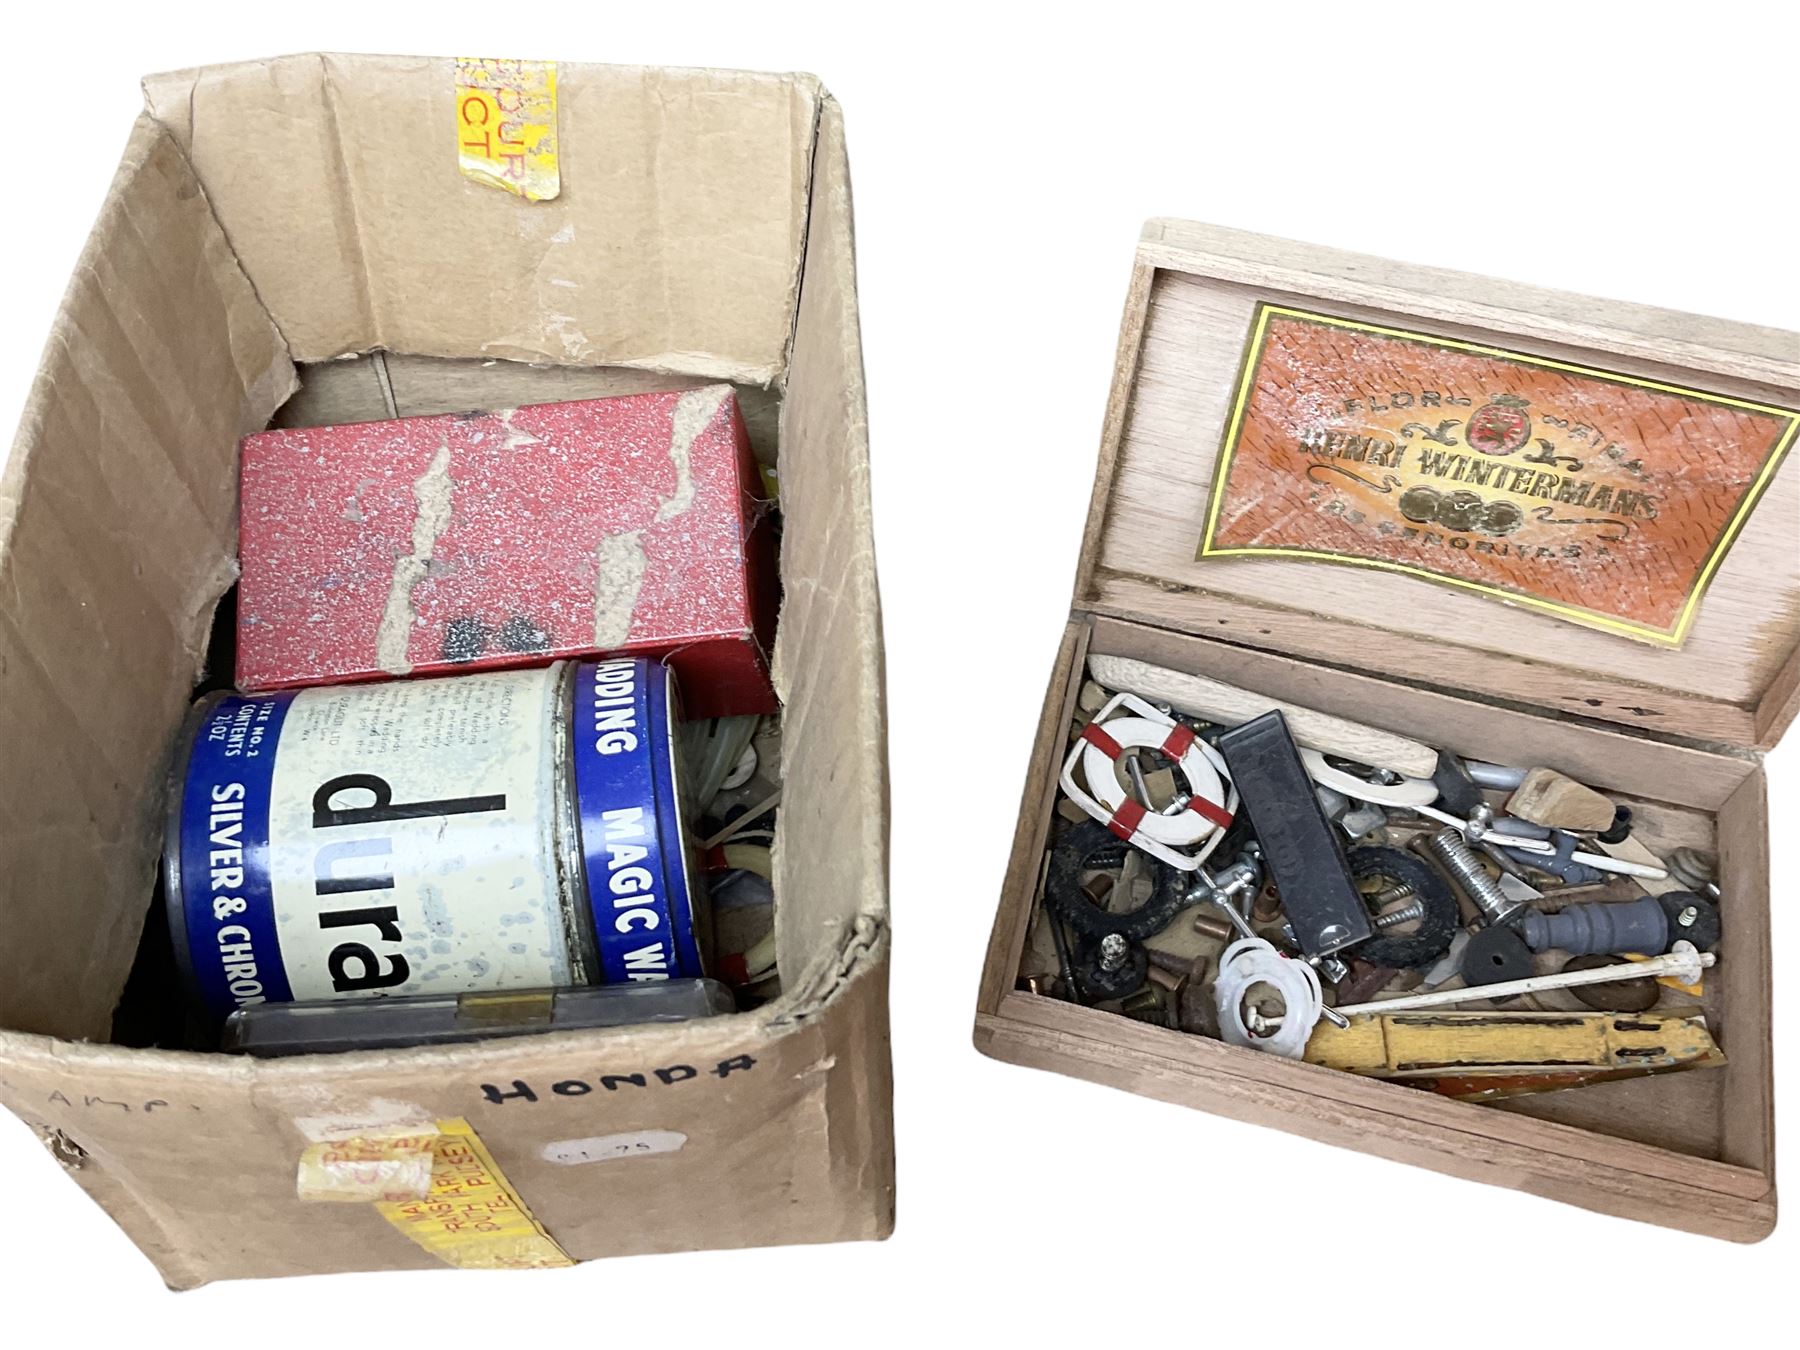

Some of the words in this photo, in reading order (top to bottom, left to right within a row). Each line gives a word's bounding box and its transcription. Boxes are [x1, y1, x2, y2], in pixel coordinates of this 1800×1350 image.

[1418, 447, 1661, 521] WINTERMANS
[224, 704, 257, 757] CONTENTS
[256, 702, 276, 722] SIZE
[594, 657, 638, 755] ADDING
[209, 782, 246, 891] SILVER
[602, 806, 659, 935] MAGIC
[212, 895, 248, 921] &
[313, 774, 506, 993] dura
[480, 1054, 757, 1104] HONDA
